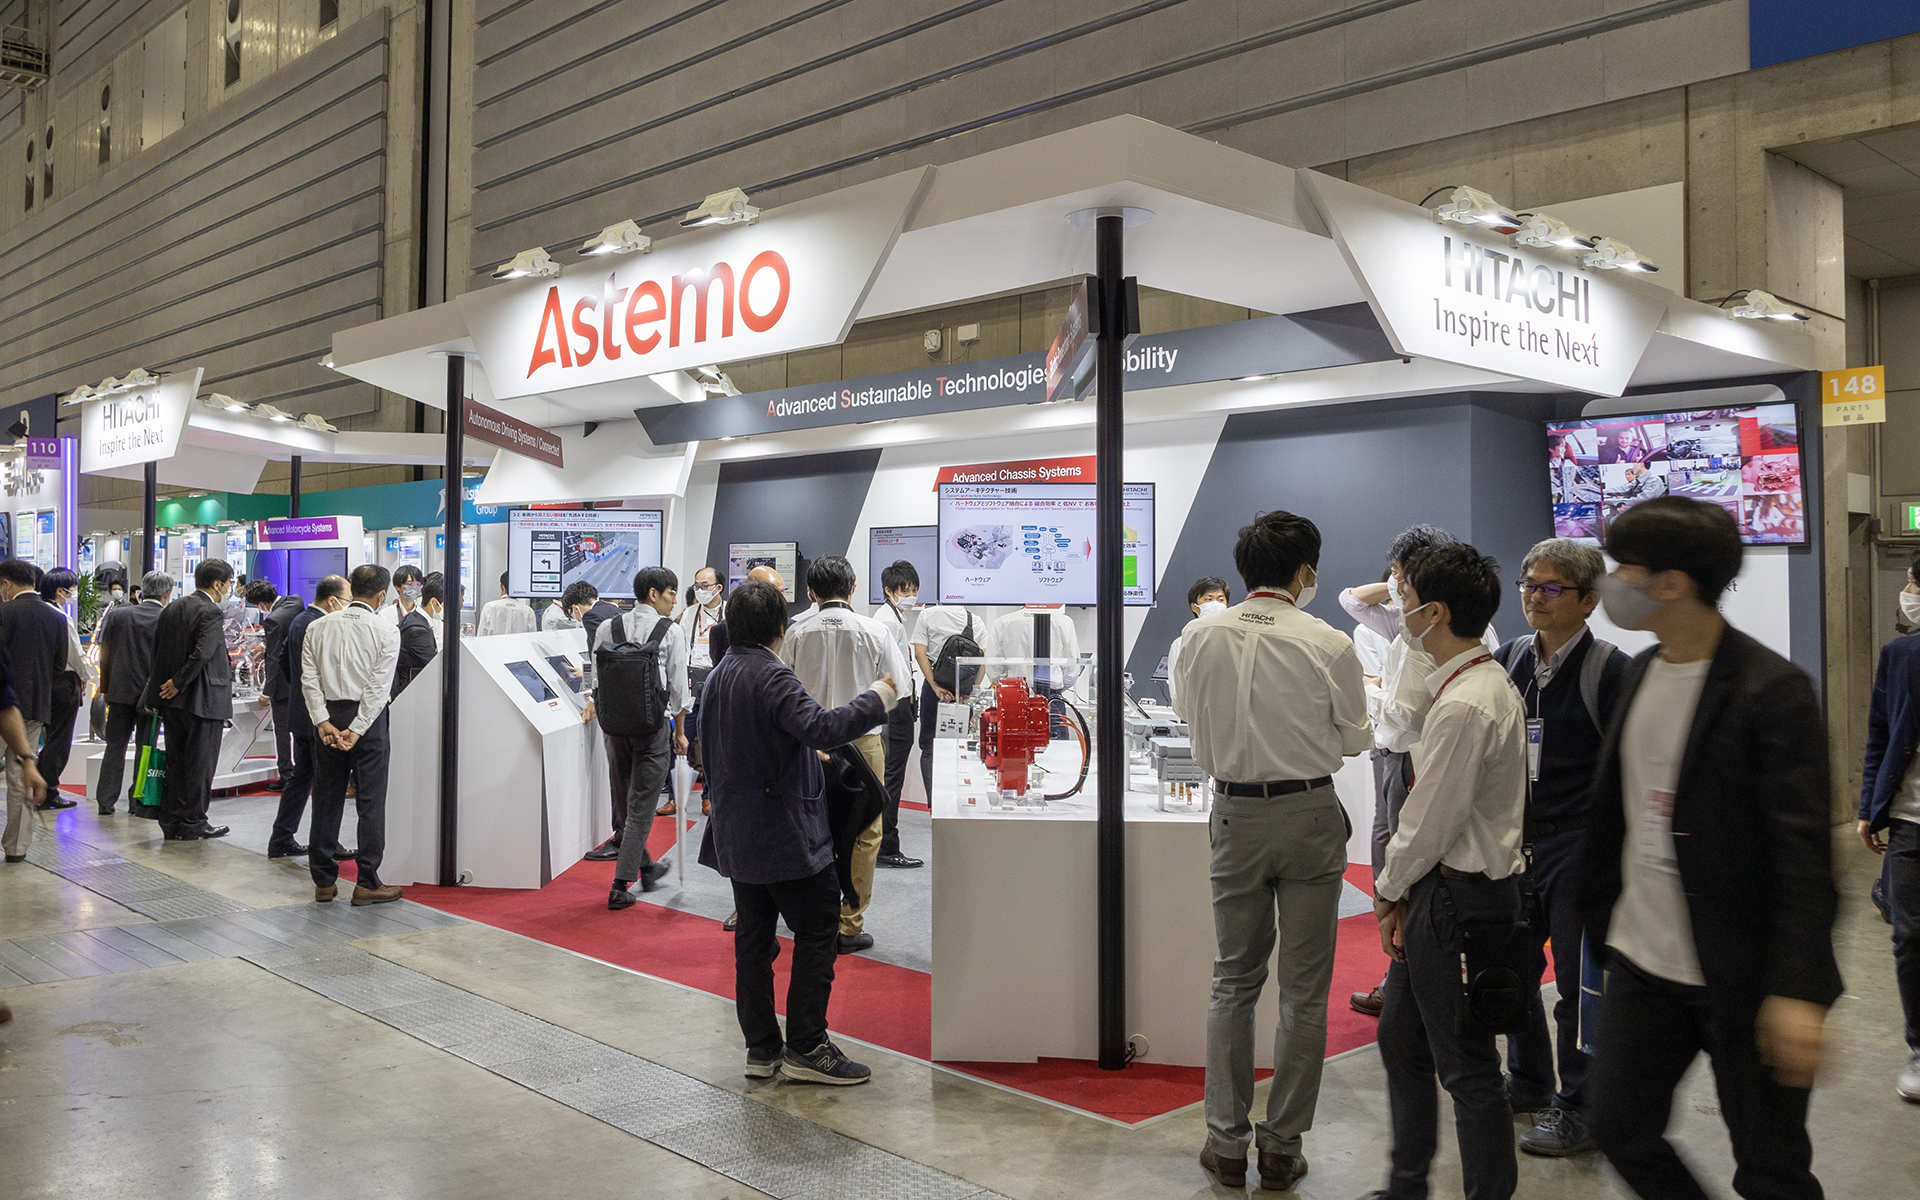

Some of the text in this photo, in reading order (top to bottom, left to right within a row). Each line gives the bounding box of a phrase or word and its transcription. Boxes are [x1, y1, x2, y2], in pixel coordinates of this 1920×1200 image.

[1443, 235, 1590, 324] HITACHI
[527, 249, 790, 380] Astemo
[1433, 297, 1600, 368] Inspire the Next
[766, 390, 837, 419] Advanced
[840, 378, 932, 409] Sustainable
[1122, 346, 1178, 374] bility
[1829, 374, 1876, 397] 148
[103, 390, 161, 431] HITACHI
[1836, 404, 1870, 413] PARTS
[468, 408, 501, 434] Autonomous
[501, 421, 517, 443] Driving
[517, 428, 536, 448] Systems
[538, 437, 560, 457] Connected
[31, 442, 57, 454] 110
[98, 426, 164, 458] Inspire the Next
[952, 465, 1082, 483] Advanced Chassis Systems
[476, 505, 498, 517] Group
[263, 523, 333, 535] Advanced Motorcycle Systems
[388, 540, 398, 549] 15
[438, 537, 445, 546] 1
[1241, 612, 1275, 622] HITACHI
[816, 1055, 838, 1072] N
